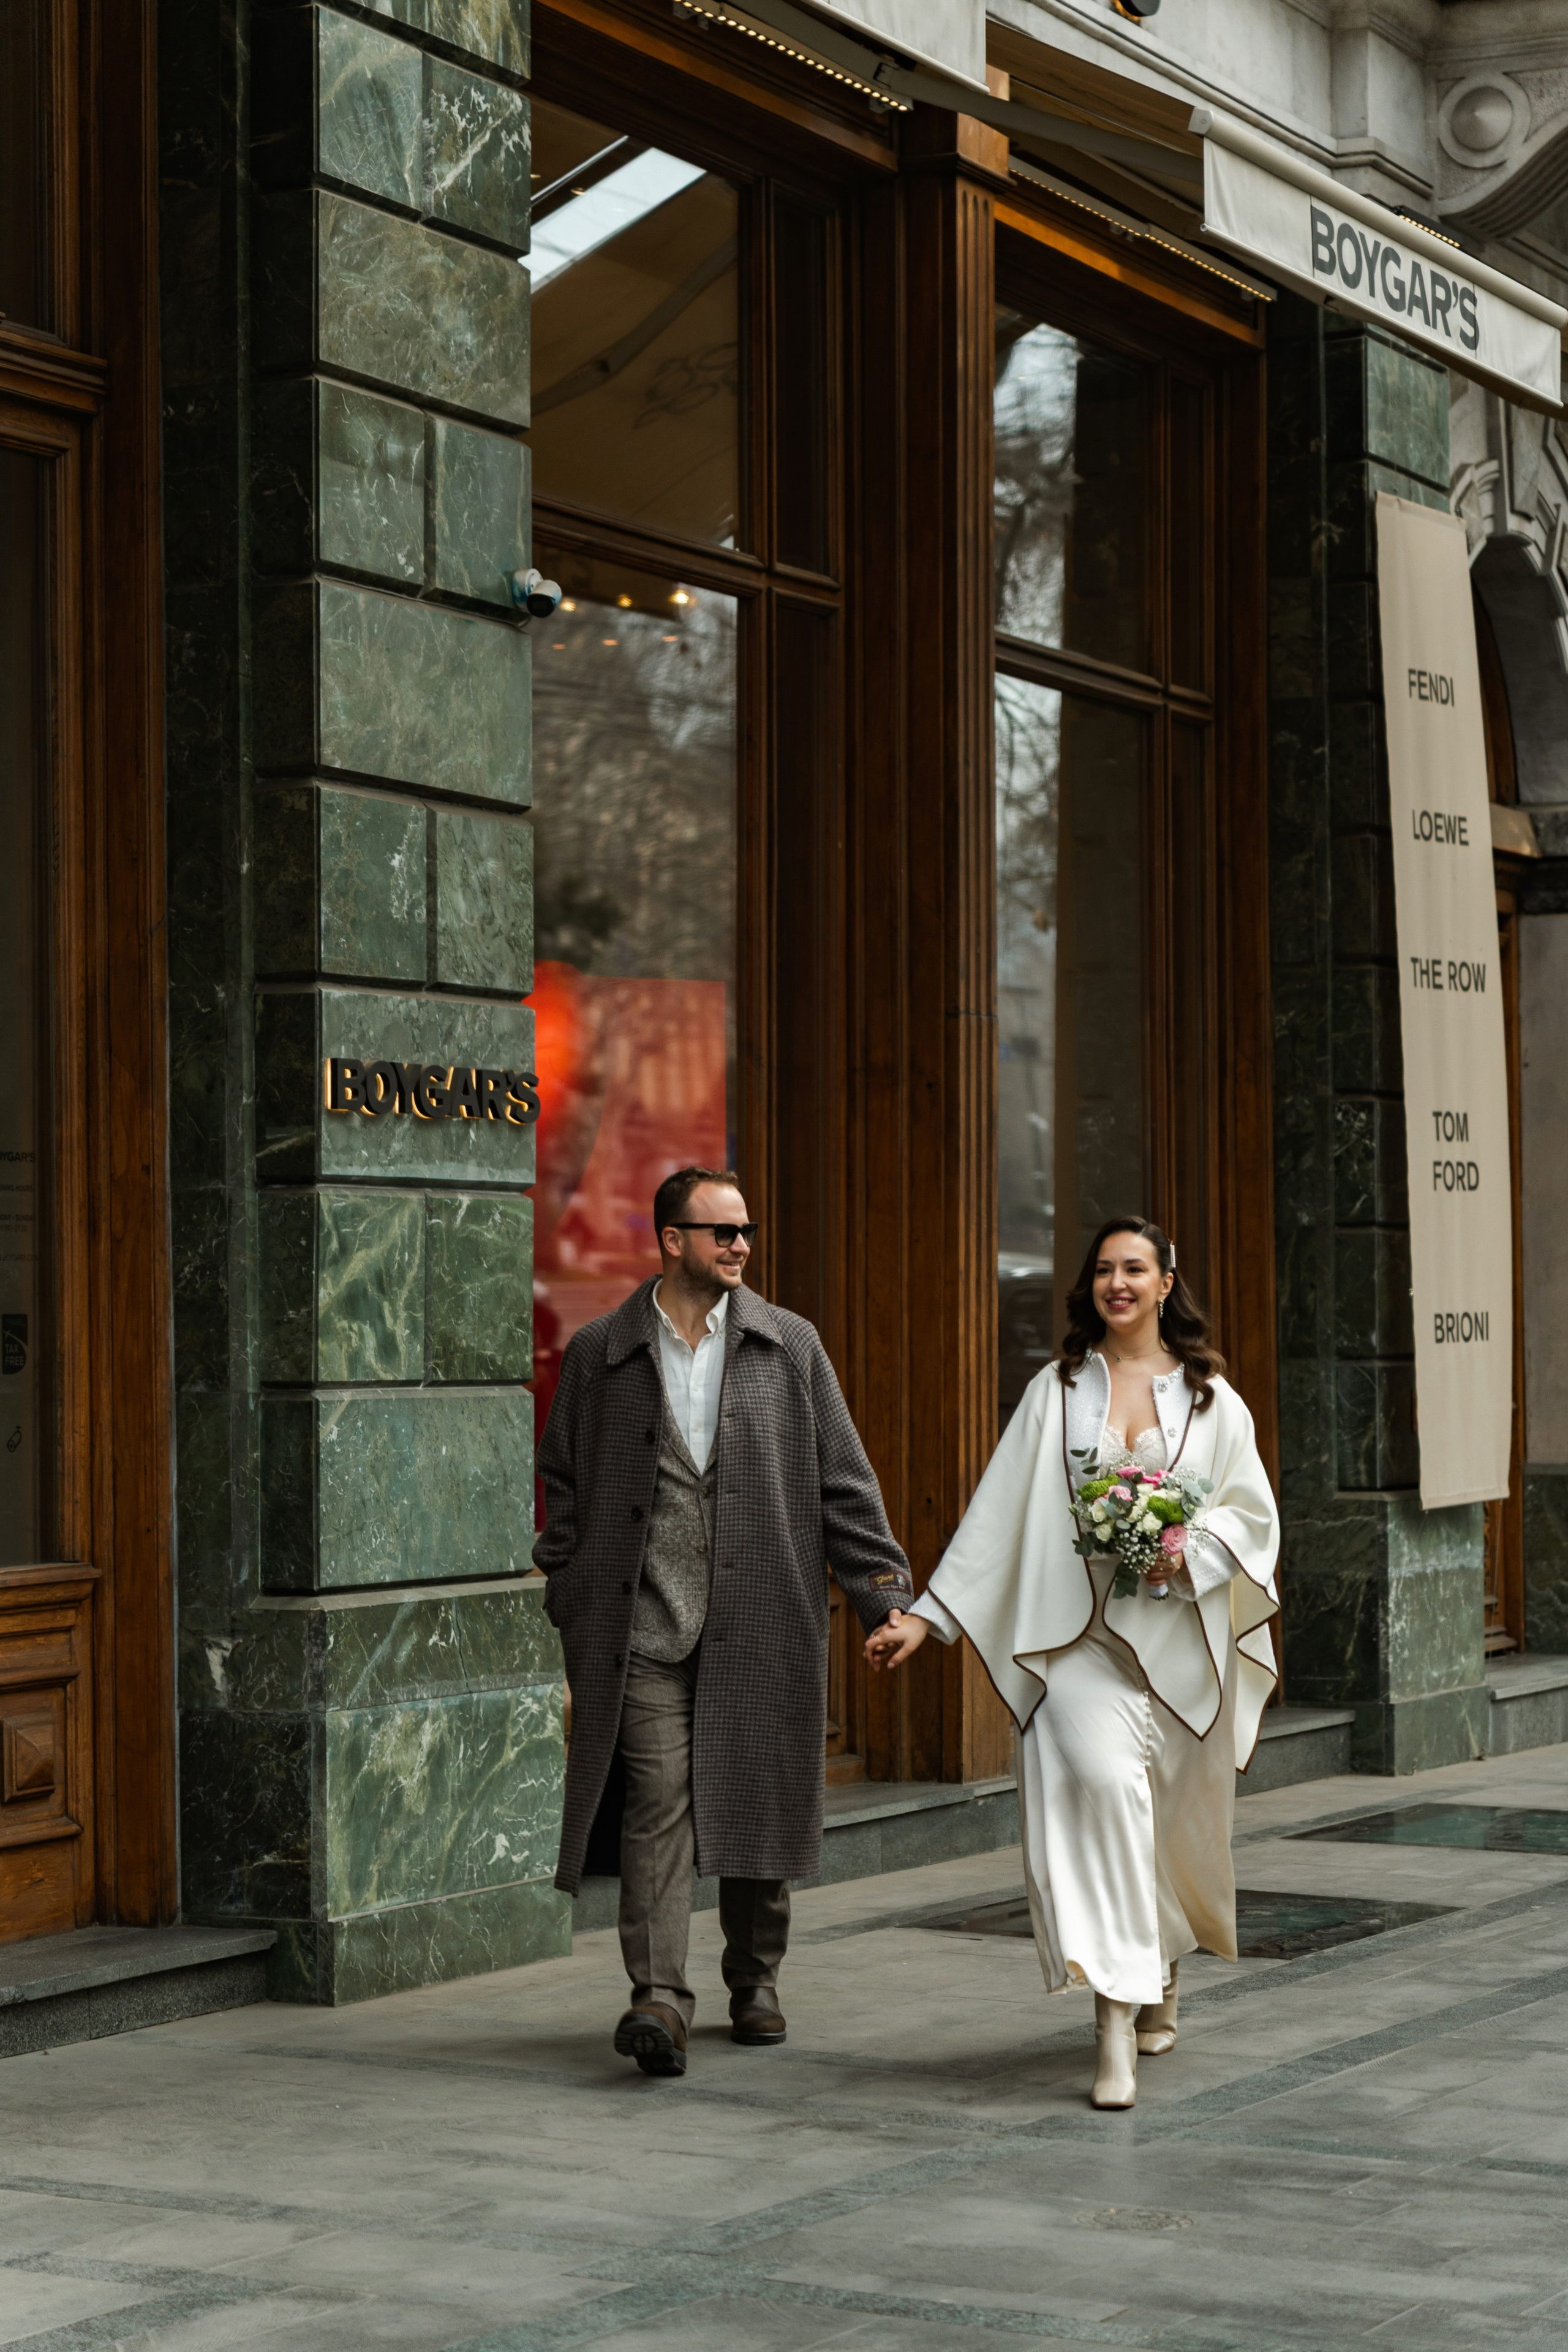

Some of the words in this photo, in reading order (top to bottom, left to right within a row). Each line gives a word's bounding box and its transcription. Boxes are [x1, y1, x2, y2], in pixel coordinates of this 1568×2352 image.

[1311, 205, 1480, 351] BOYGAR'S
[1408, 668, 1454, 706] FENDI
[1412, 810, 1469, 846] LOEWE
[1411, 957, 1444, 990] THE
[1448, 961, 1485, 992] ROW
[325, 1058, 540, 1125] BOYGAR'S
[1433, 1111, 1469, 1142] TOM
[0, 1152, 35, 1163] YGAR'S
[1433, 1161, 1479, 1192] FORD
[1434, 1312, 1488, 1344] BRIONI
[5, 1344, 19, 1354] TAX
[5, 1356, 24, 1366] FREE
